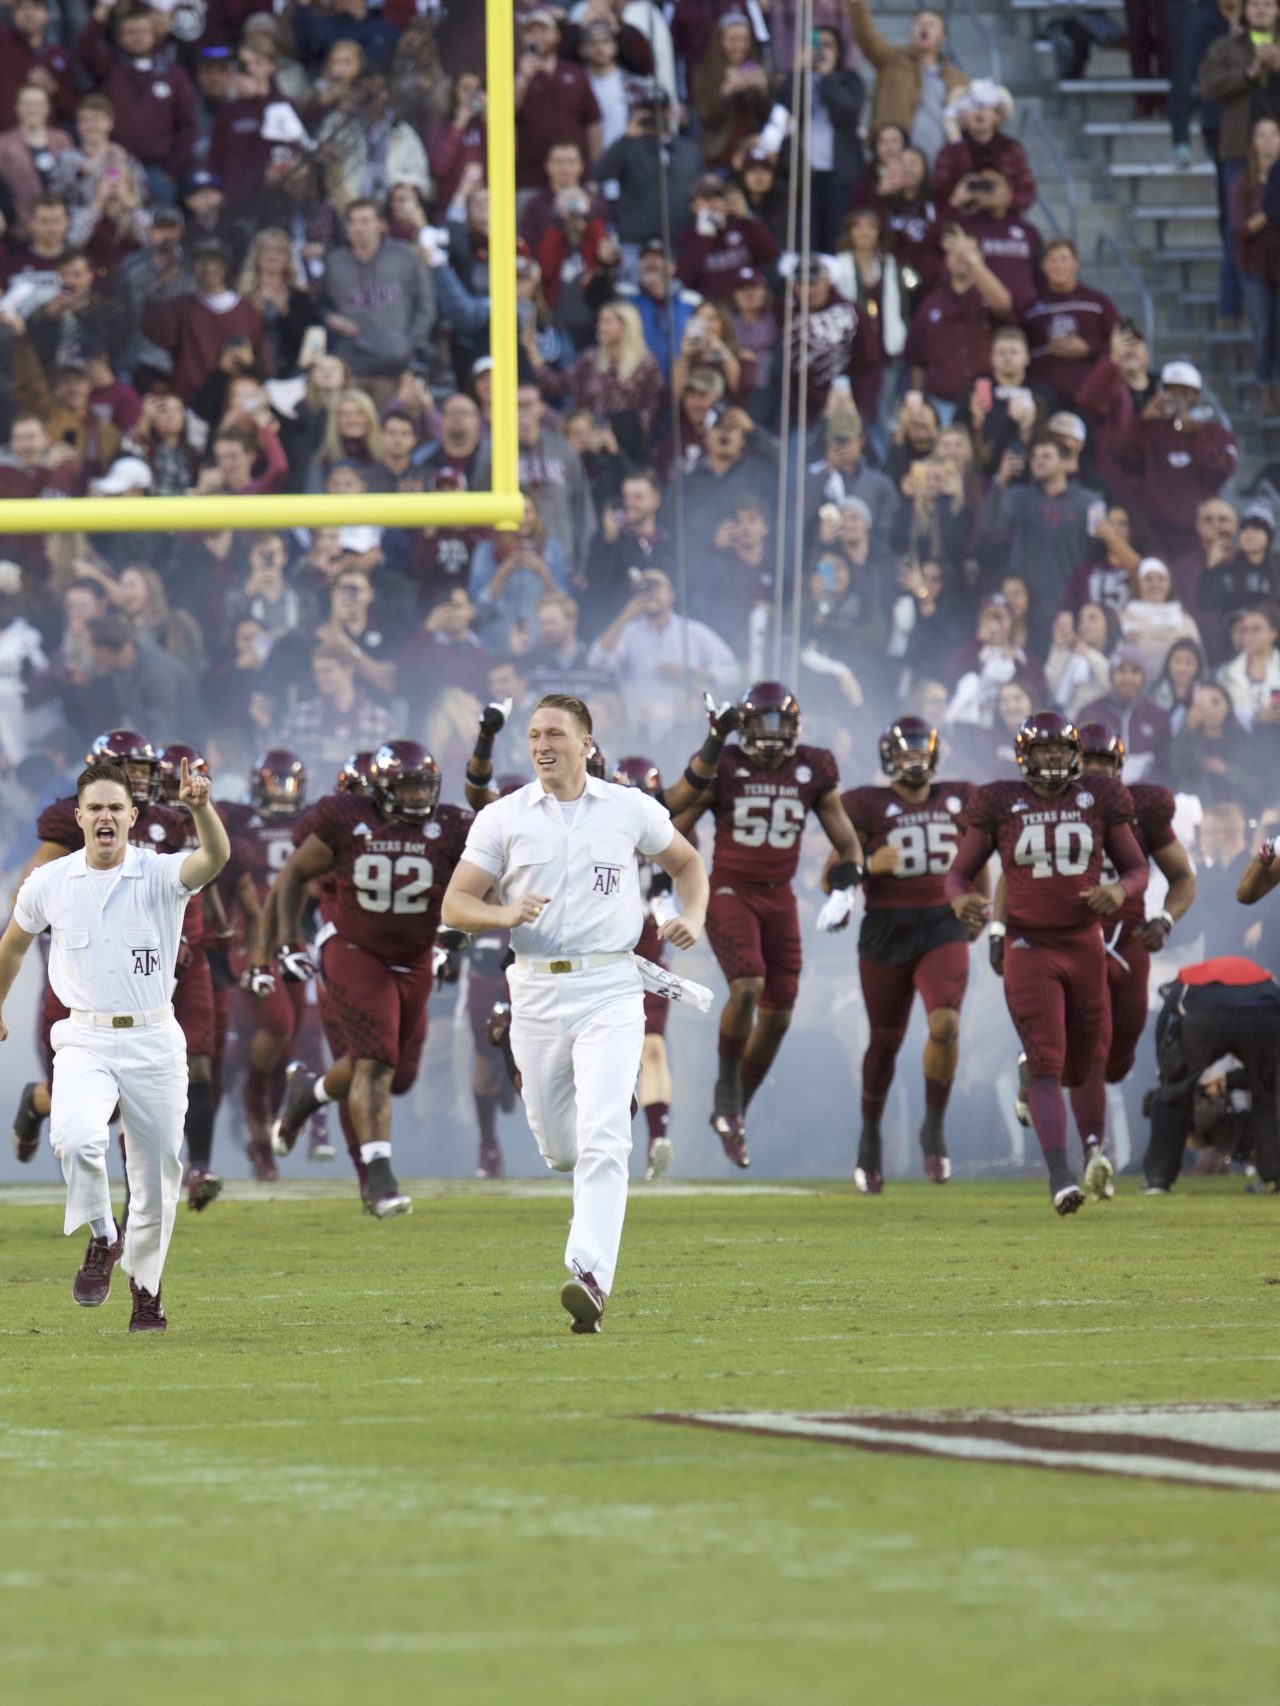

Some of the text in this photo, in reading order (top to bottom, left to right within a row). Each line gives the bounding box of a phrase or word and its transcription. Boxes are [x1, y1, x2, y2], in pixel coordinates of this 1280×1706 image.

[733, 797, 804, 849] 56
[1022, 810, 1058, 825] TEXAS
[366, 840, 401, 852] TEXAS
[887, 822, 959, 878] 85
[1014, 822, 1093, 879] 40
[353, 854, 433, 914] 92
